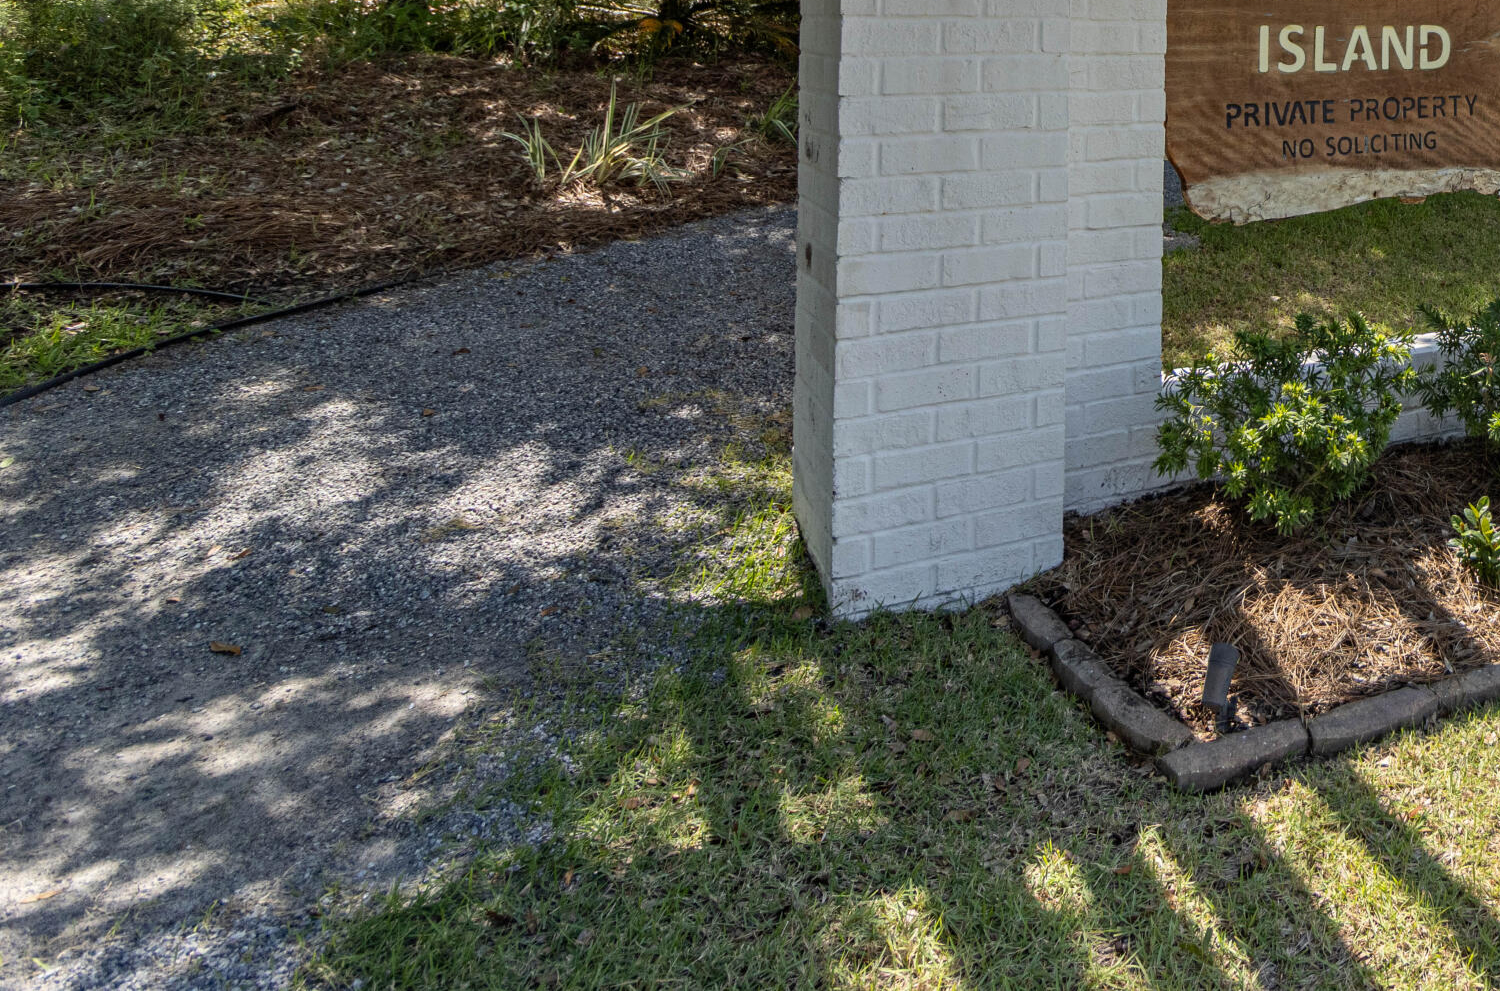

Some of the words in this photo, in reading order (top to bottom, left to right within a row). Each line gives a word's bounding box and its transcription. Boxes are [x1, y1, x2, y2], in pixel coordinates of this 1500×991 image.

[1258, 24, 1451, 73] ISLAND
[1225, 99, 1336, 129] PRIVATE
[1349, 94, 1478, 122] PROPERTY
[1282, 138, 1315, 160] NO
[1325, 130, 1437, 157] SOLICITING
